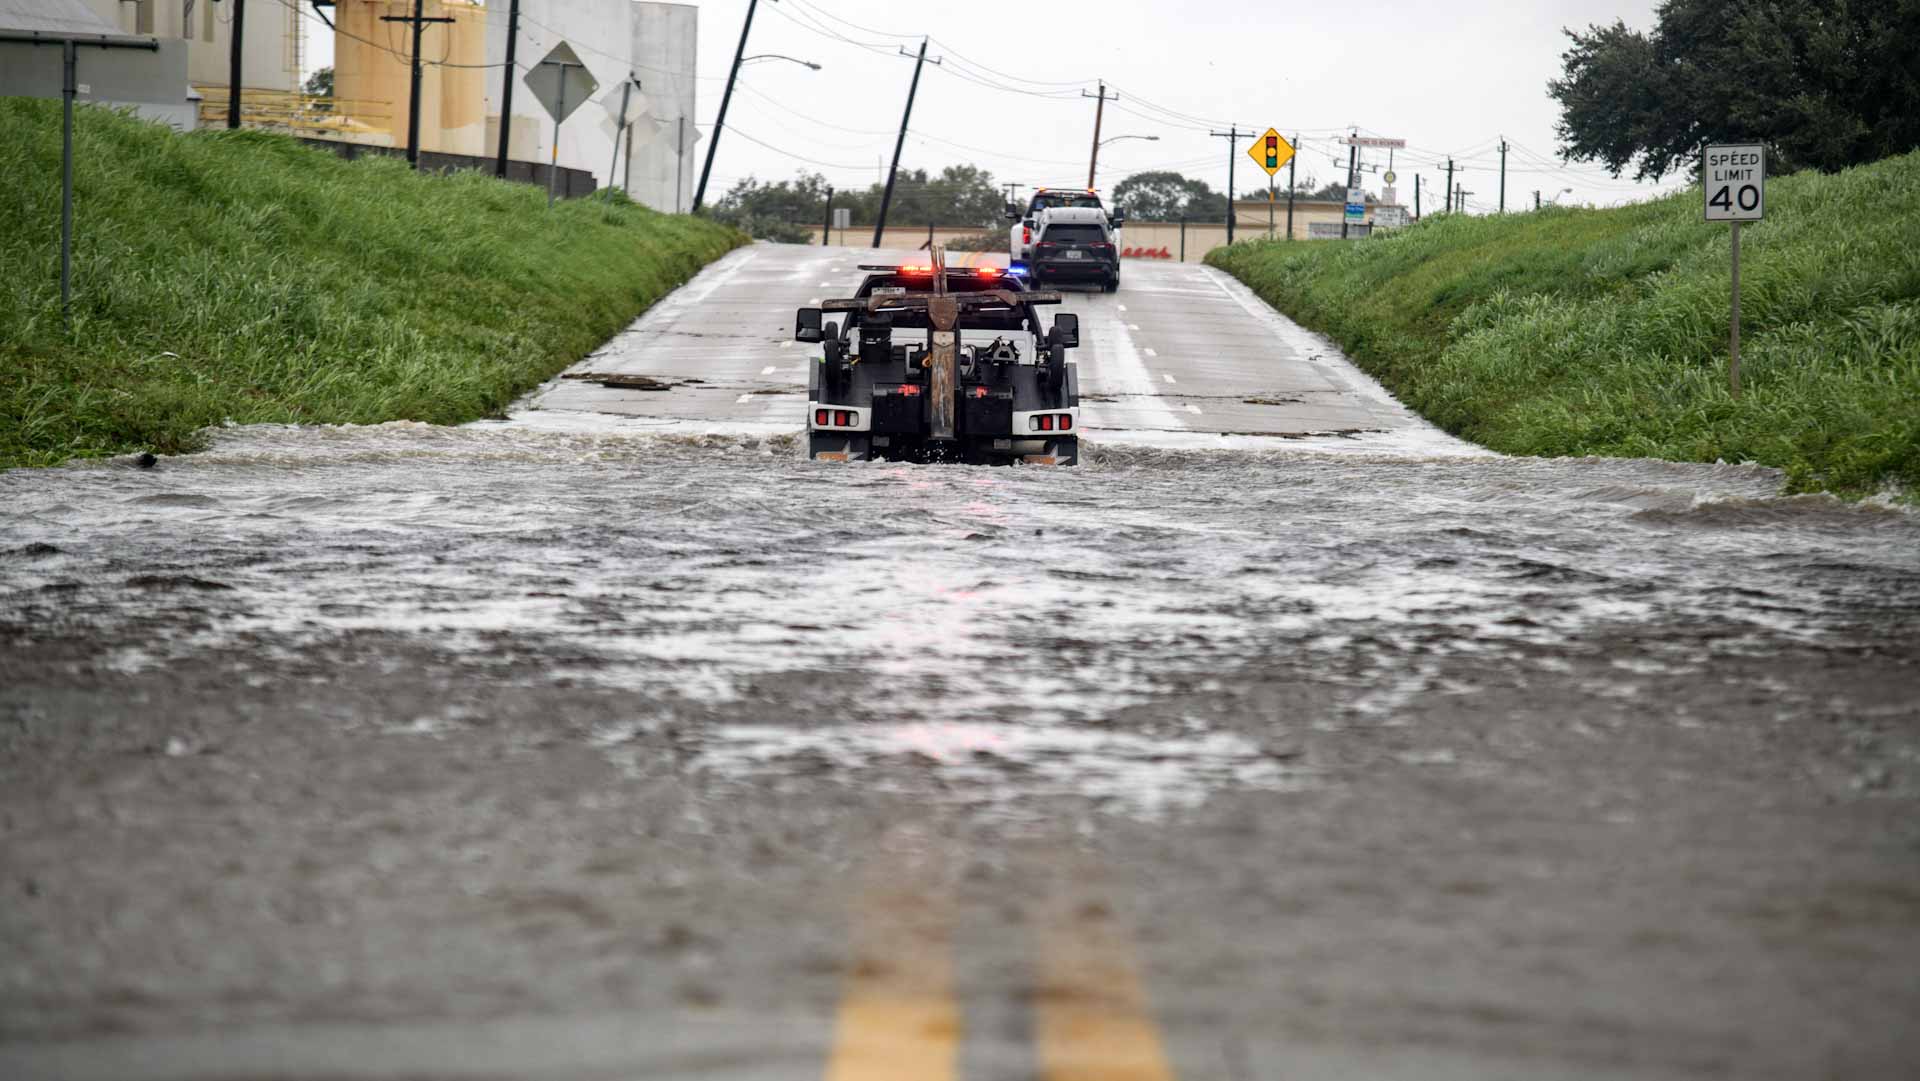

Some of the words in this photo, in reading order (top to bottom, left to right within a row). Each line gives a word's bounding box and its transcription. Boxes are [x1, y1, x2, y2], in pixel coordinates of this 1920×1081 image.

[1709, 153, 1760, 166] SPEED
[1715, 169, 1753, 181] LIMIT
[1709, 184, 1760, 211] 40
